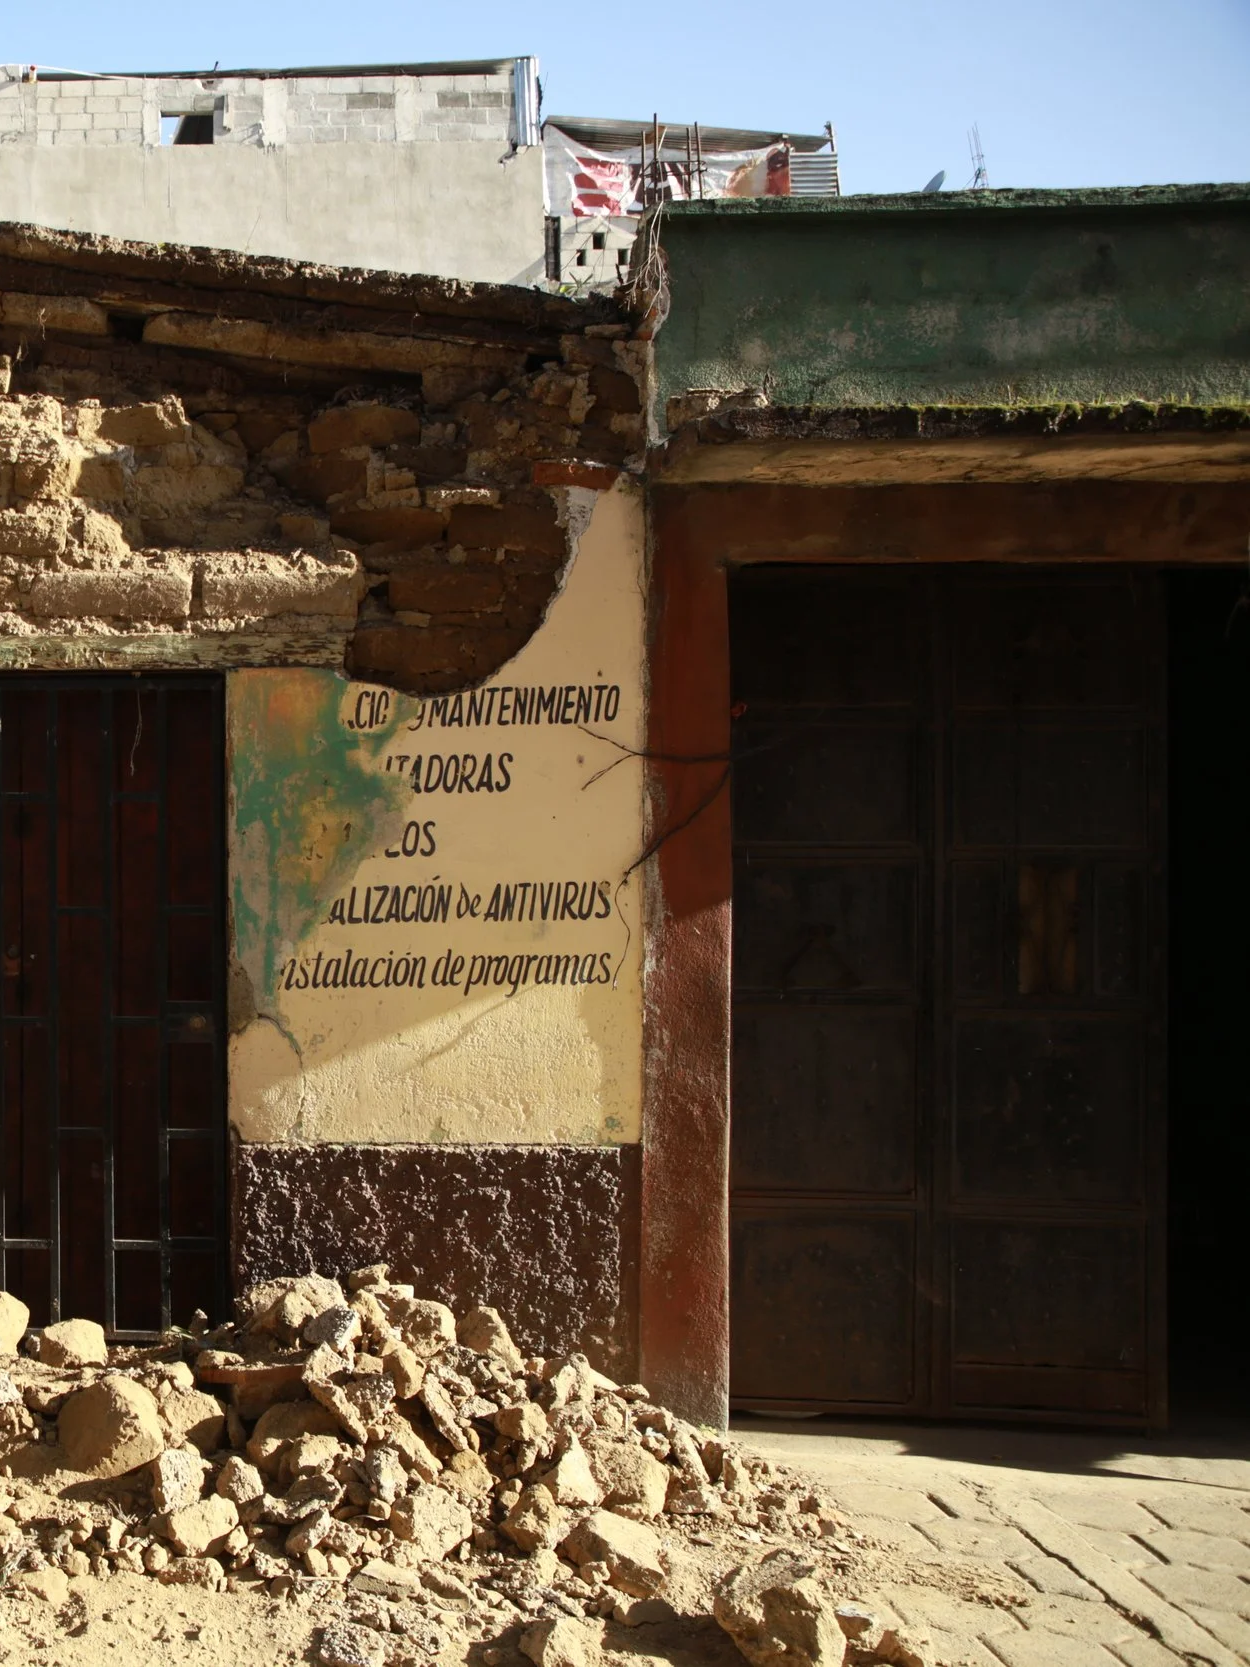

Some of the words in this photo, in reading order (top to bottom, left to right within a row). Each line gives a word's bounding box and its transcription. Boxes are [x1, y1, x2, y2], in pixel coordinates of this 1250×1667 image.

[427, 685, 620, 729] MANTENIMIENTO
[321, 875, 452, 925] ALIZACIÓN
[456, 882, 482, 919] de
[483, 881, 611, 922] ANTIVIRUS
[277, 948, 426, 991] nstalación
[431, 948, 466, 986] de
[463, 952, 612, 998] programas
